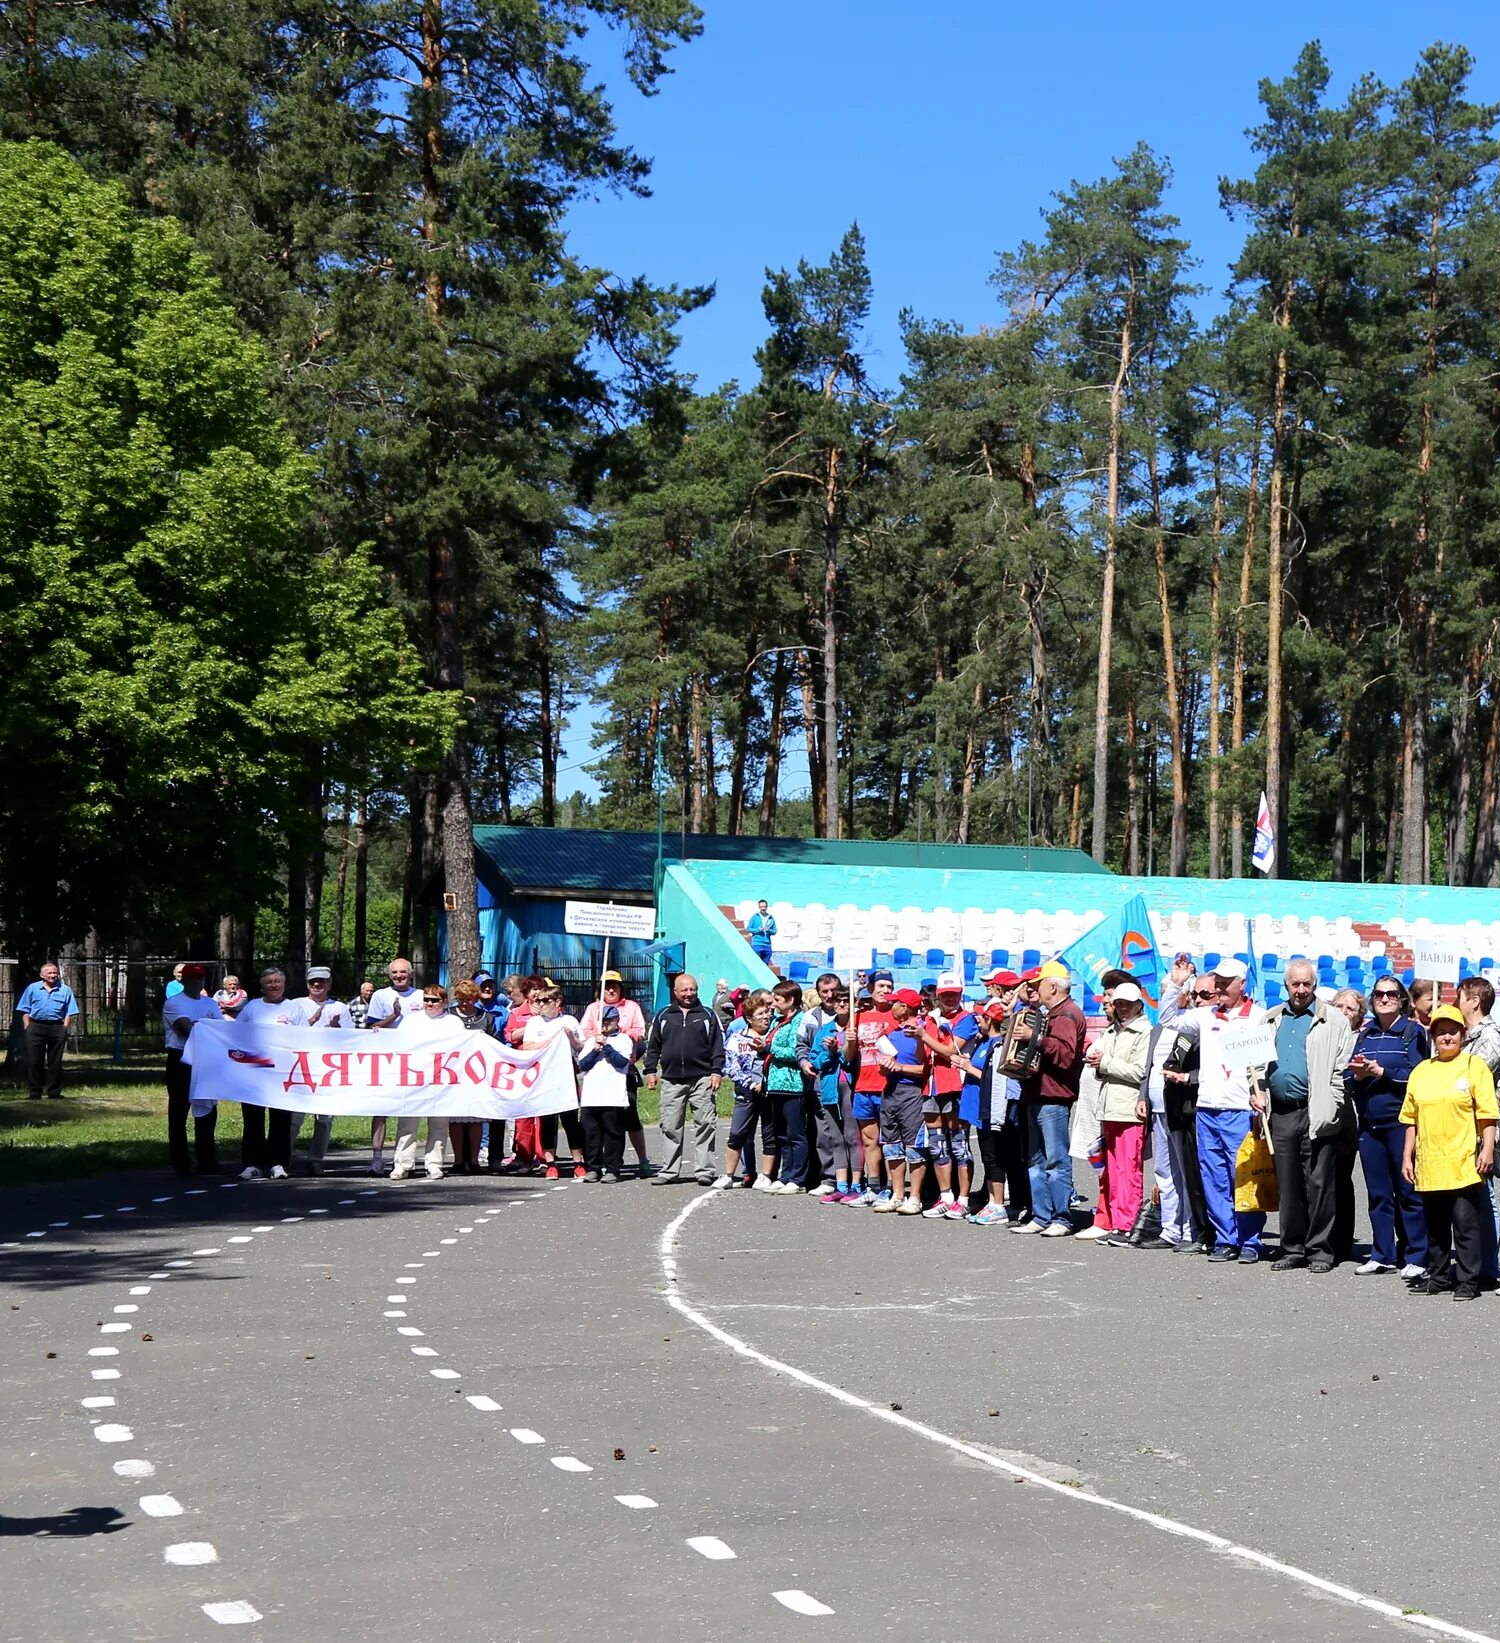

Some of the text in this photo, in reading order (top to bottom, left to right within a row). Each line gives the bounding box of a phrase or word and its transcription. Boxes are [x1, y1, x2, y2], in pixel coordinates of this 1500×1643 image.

[1420, 952, 1454, 964] НАВЛЯ
[1225, 1035, 1270, 1050] СТАРОДУБ
[282, 1049, 541, 1094] ДЯТЬКОВО
